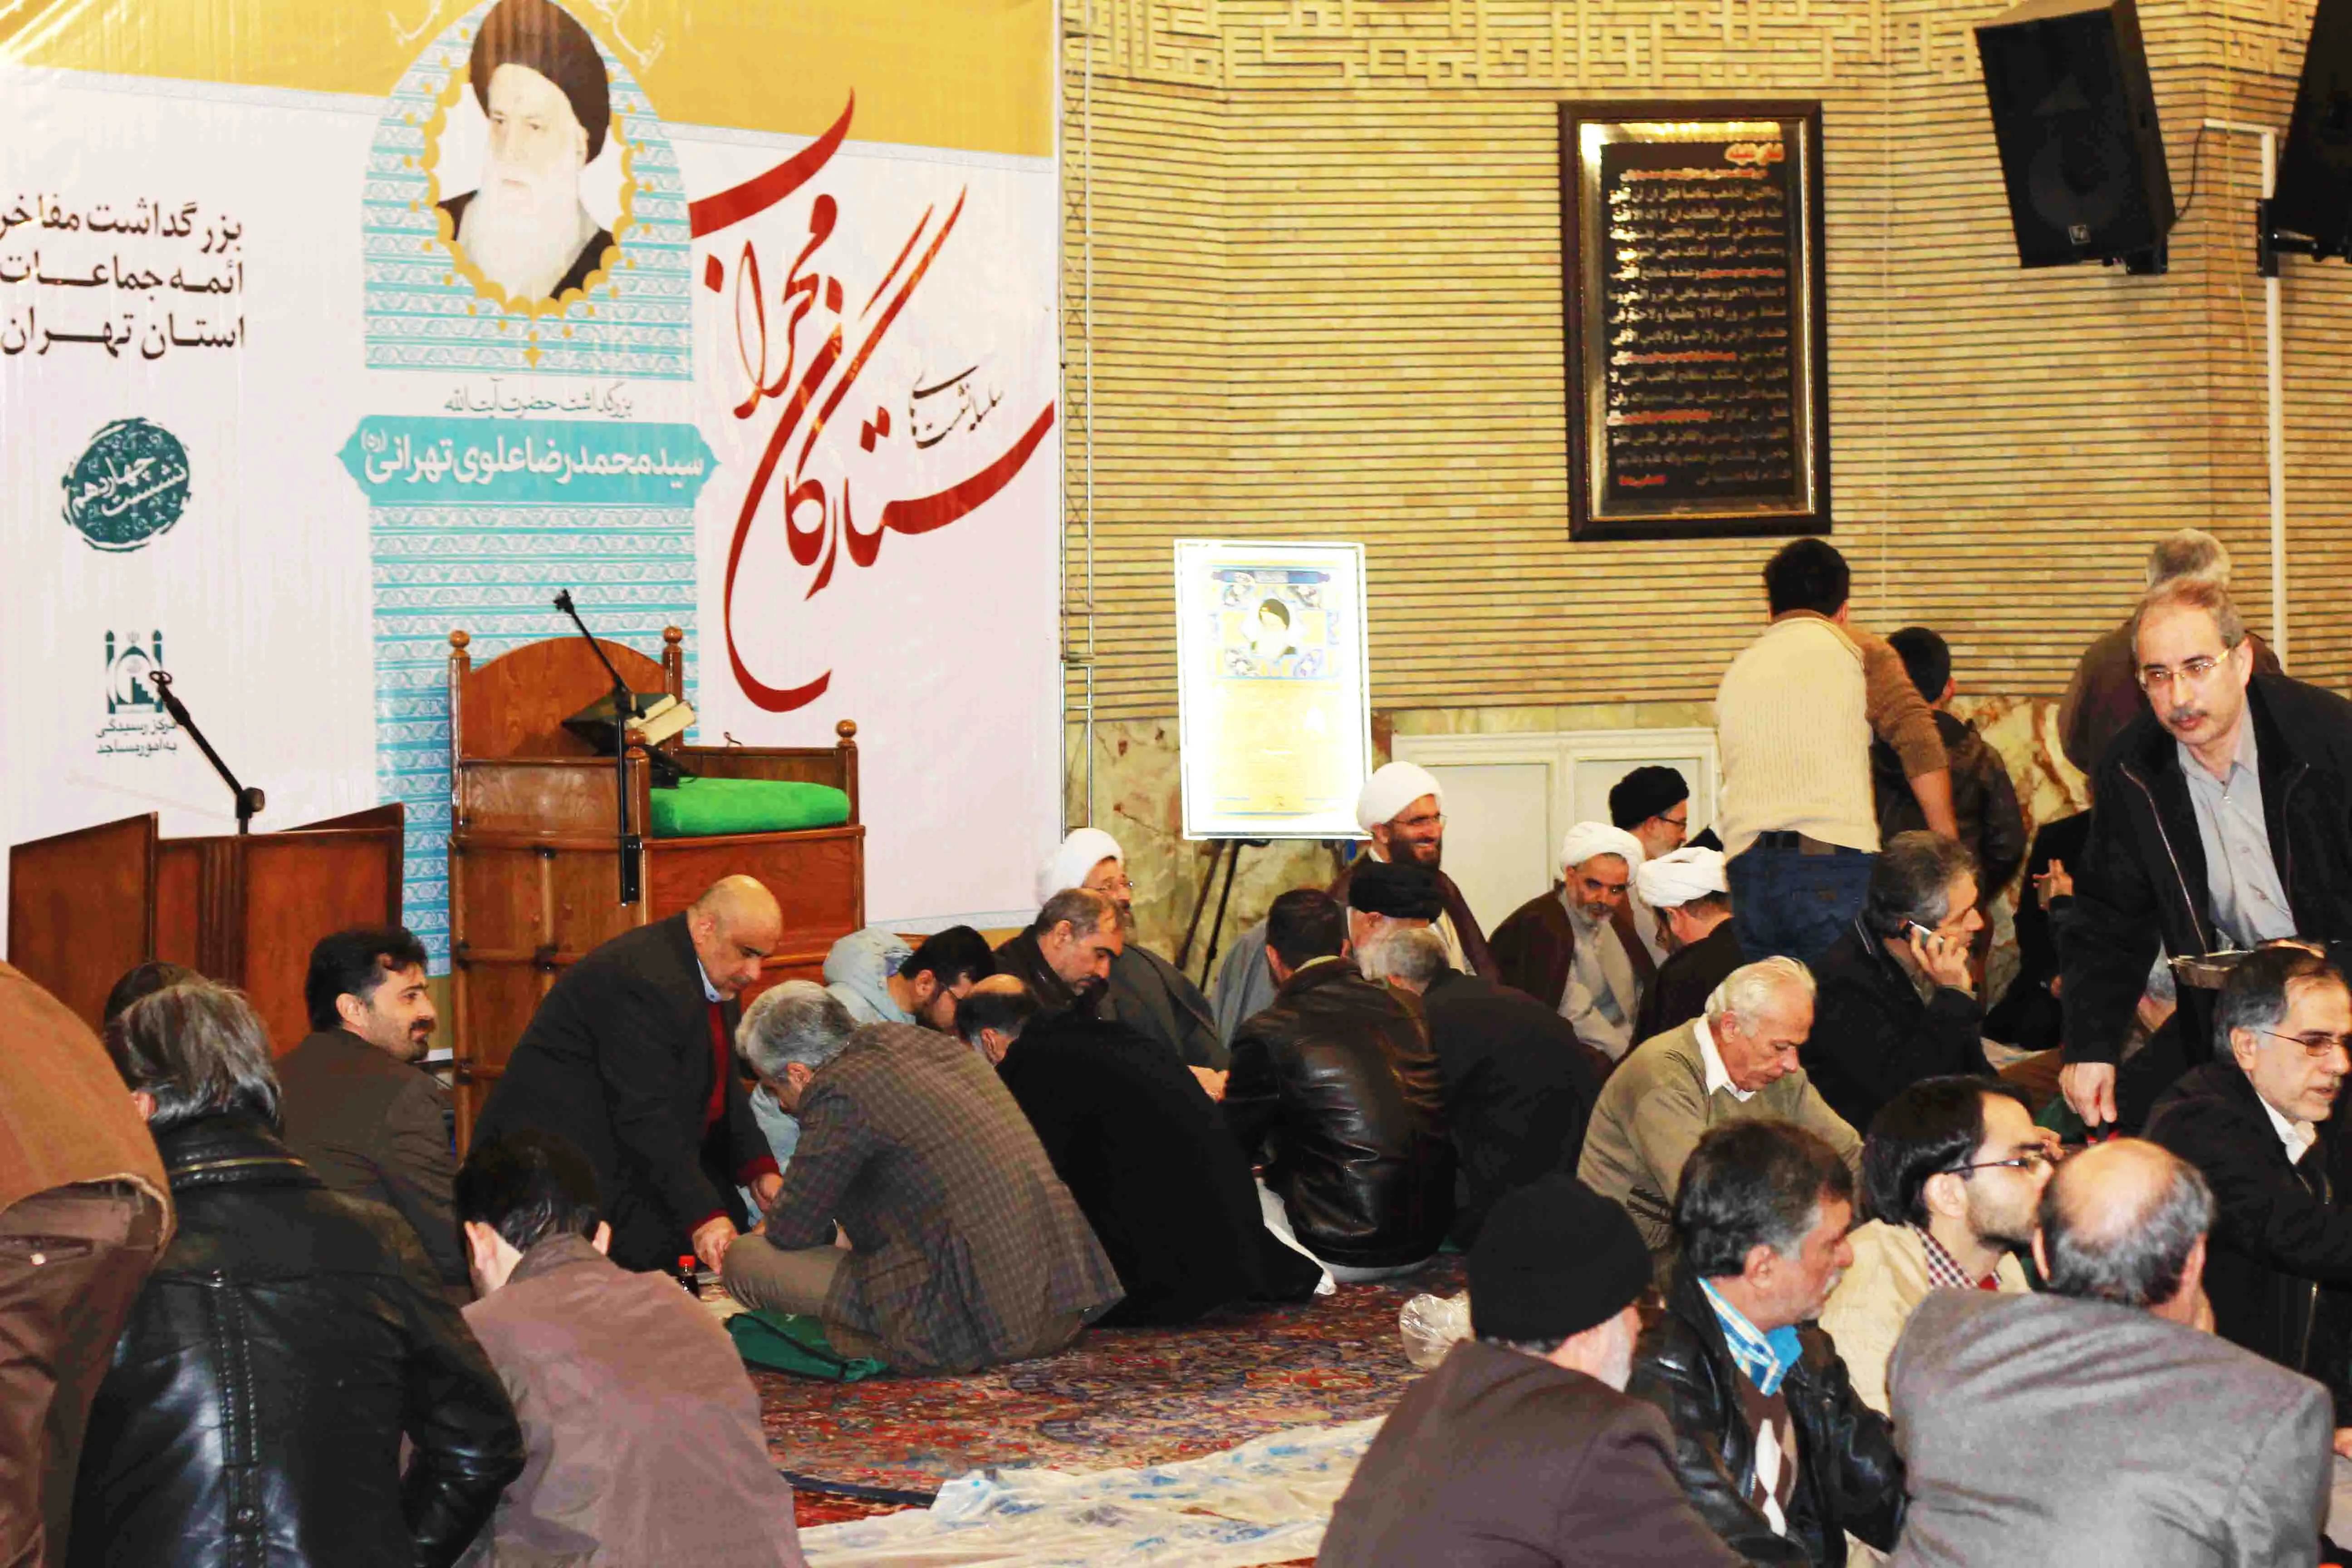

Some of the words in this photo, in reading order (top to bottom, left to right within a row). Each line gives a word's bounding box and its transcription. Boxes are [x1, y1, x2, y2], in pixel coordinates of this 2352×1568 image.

[87, 197, 242, 253] بزرگداشت
[0, 250, 163, 301] جماعات
[1, 305, 134, 358] تهران
[142, 313, 244, 360] استان
[500, 395, 558, 419] حضرت
[364, 434, 454, 485] تهرانی
[453, 434, 528, 485] علوی
